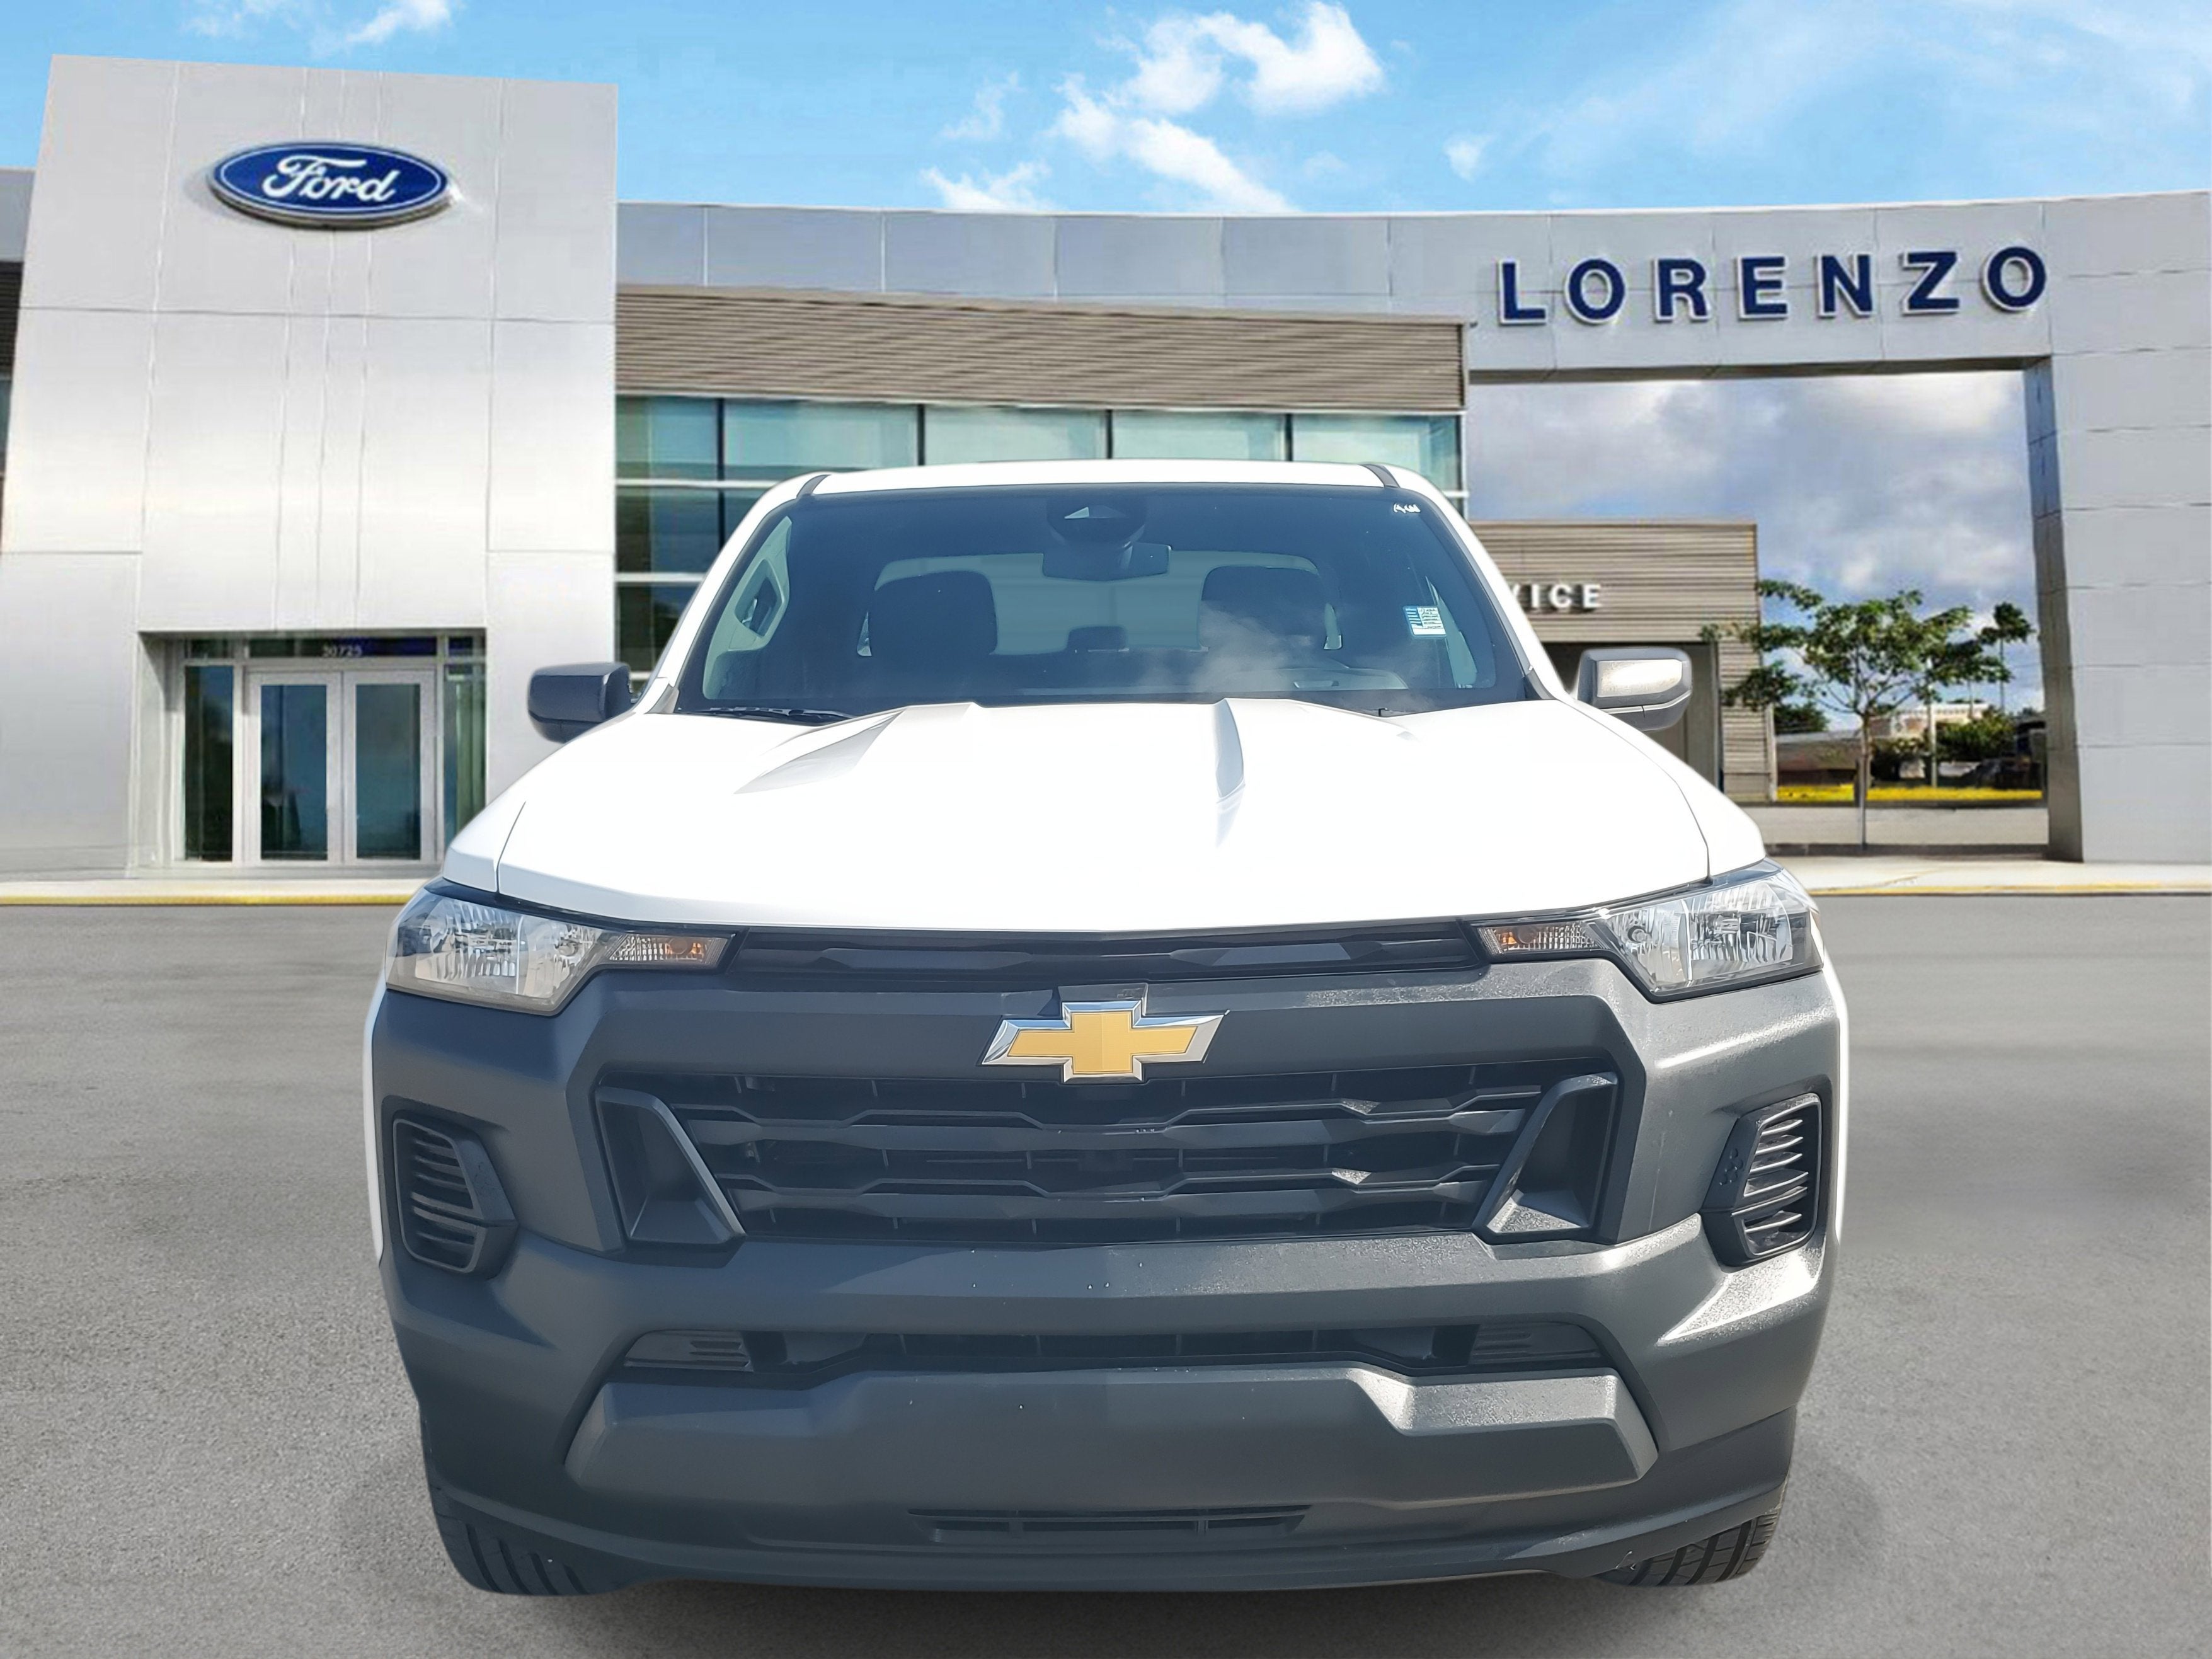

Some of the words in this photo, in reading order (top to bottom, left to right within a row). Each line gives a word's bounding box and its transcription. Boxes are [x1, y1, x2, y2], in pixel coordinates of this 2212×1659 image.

[262, 155, 400, 202] Ford
[1499, 246, 2048, 325] LORENZO
[1512, 583, 1602, 609] ICE
